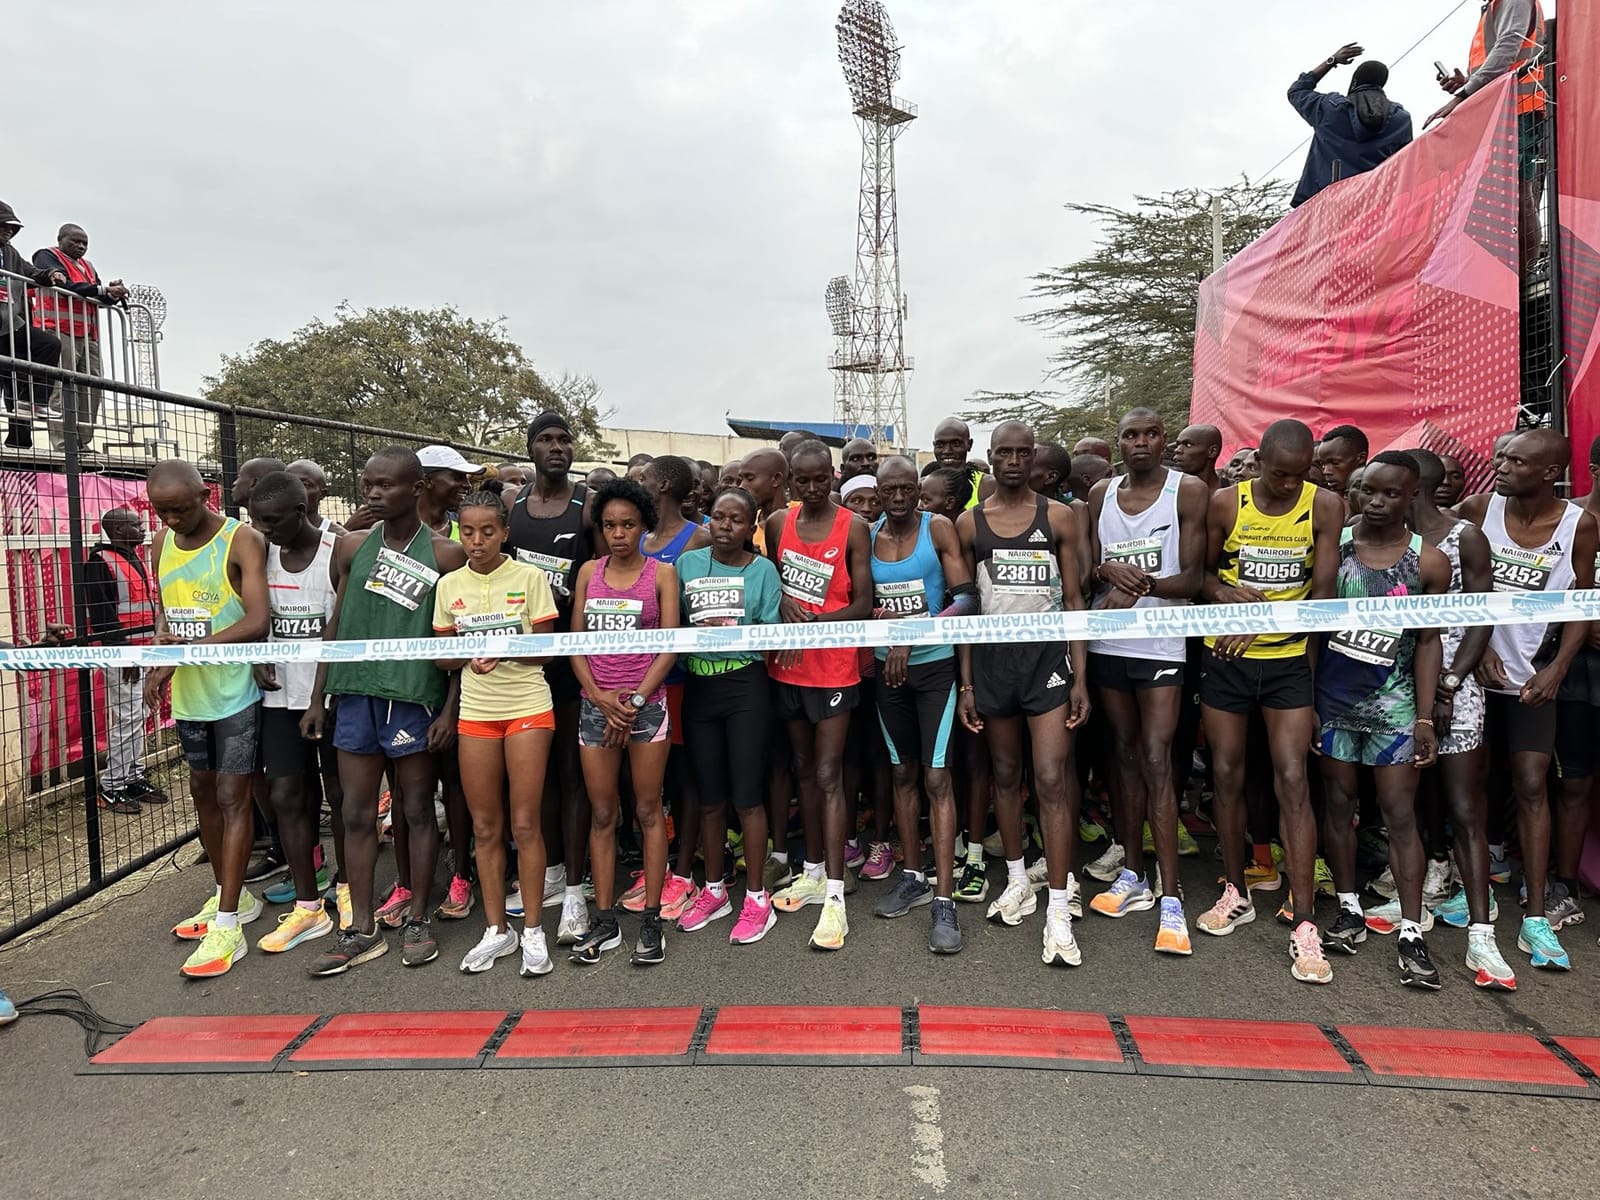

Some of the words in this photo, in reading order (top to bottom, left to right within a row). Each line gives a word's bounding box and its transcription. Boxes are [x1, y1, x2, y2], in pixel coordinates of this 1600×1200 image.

[528, 553, 558, 564] NAIROBI
[1257, 548, 1293, 556] NAIROBI
[1501, 547, 1538, 561] NAIROBI
[1543, 549, 1565, 557] adidas
[395, 554, 426, 573] NAIROBI
[794, 554, 822, 569] NAIROBI
[1110, 552, 1158, 569] 416
[997, 564, 1047, 581] 23810
[1244, 561, 1300, 578] 20056
[376, 564, 425, 596] 20471
[781, 565, 825, 593] 20452
[690, 590, 740, 608] 23629
[880, 595, 922, 612] 23193
[280, 605, 311, 613] NAIROBI
[274, 618, 322, 634] 20744
[471, 613, 504, 623] NAIROBI
[587, 614, 636, 631] 21532
[391, 736, 416, 747] adidas
